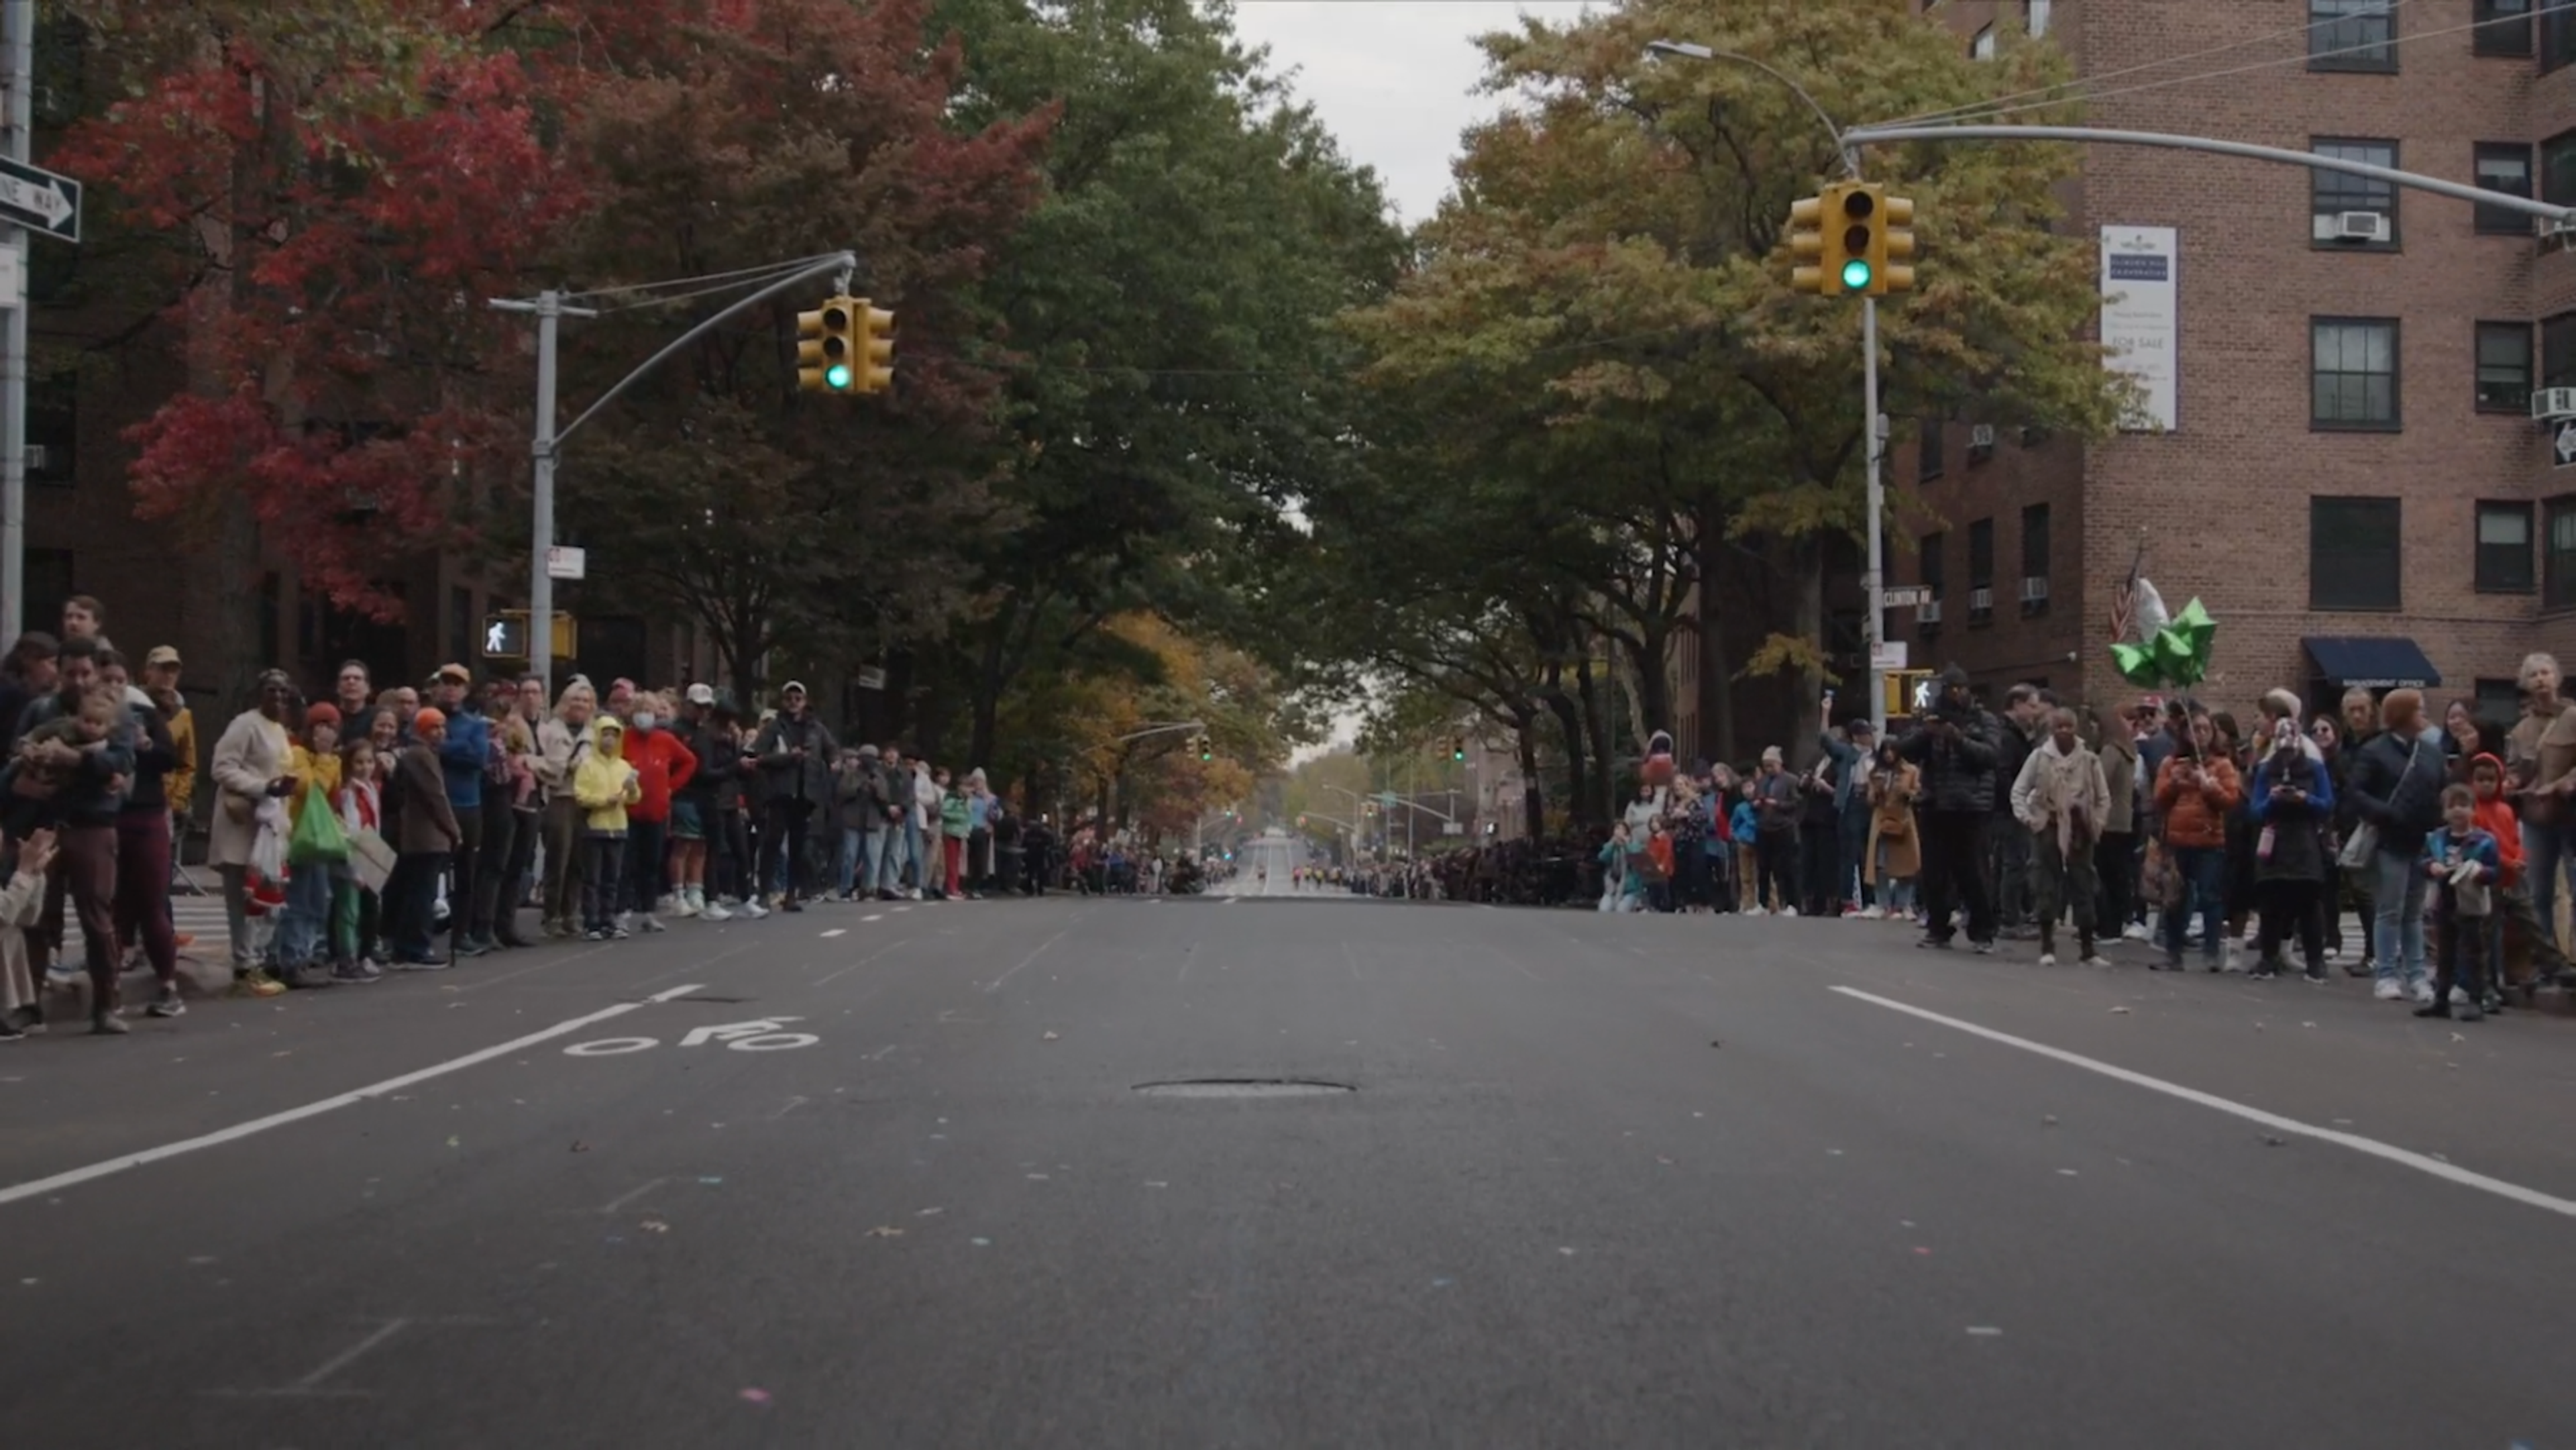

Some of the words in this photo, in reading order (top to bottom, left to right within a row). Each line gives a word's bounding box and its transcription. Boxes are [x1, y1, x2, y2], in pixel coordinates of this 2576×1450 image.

[0, 176, 21, 204] NE
[34, 189, 62, 211] WAY
[2139, 336, 2164, 350] SALE
